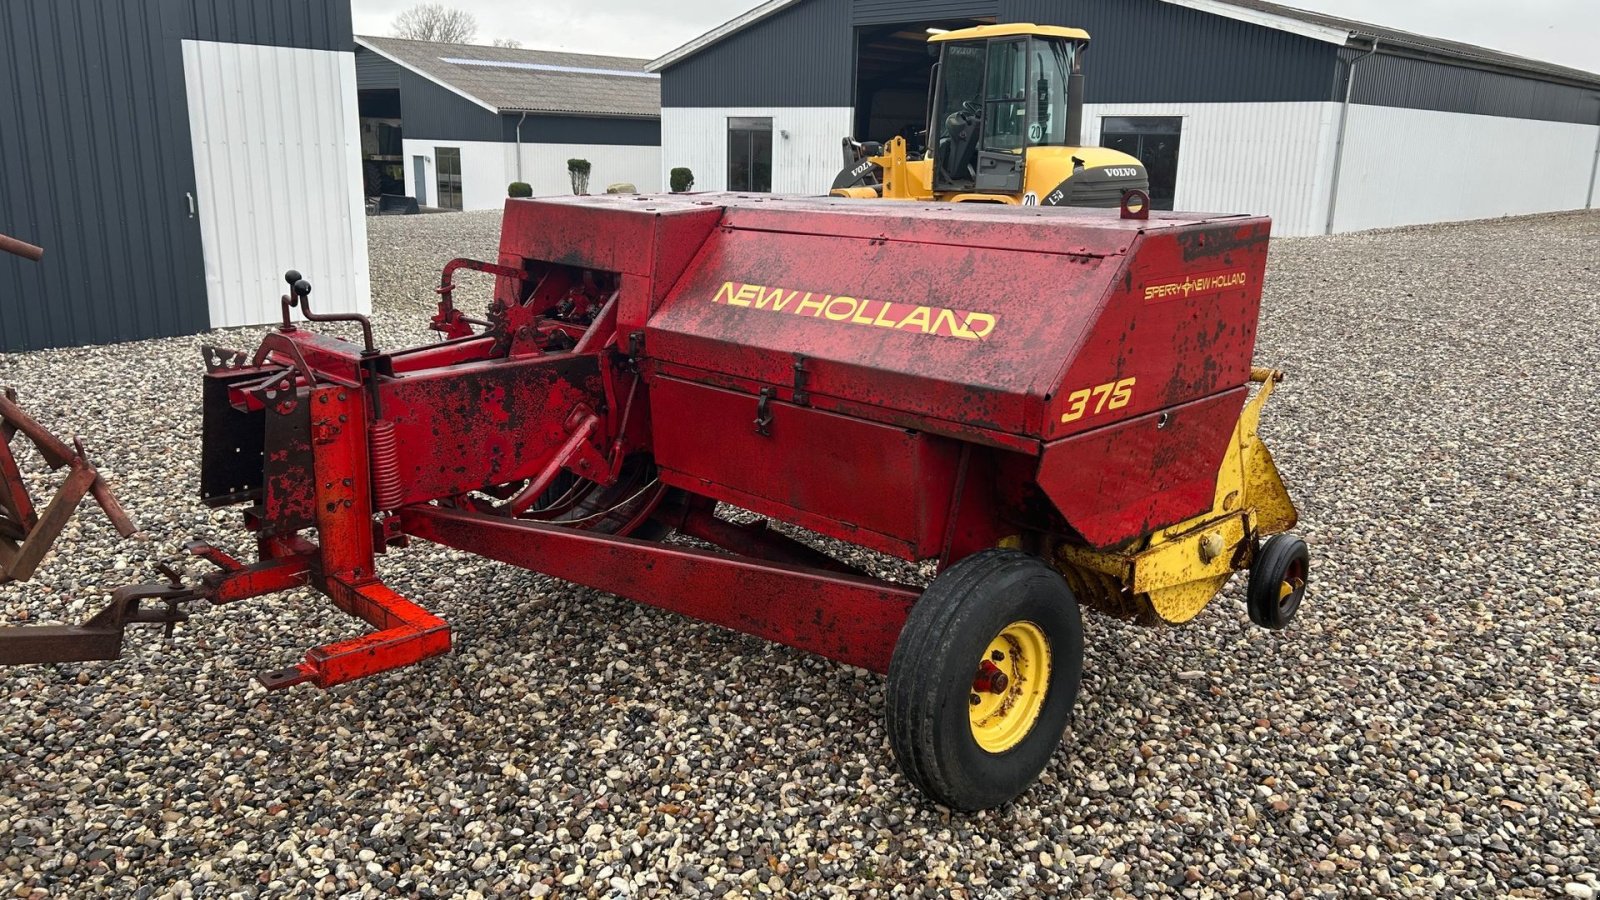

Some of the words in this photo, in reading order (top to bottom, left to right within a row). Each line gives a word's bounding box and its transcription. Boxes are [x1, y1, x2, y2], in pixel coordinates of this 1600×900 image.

[1031, 125, 1041, 139] 20
[851, 160, 873, 177] VOLV
[1103, 167, 1137, 177] VOLVO
[1025, 194, 1036, 206] 20
[1144, 283, 1182, 300] SPERRY
[1191, 277, 1211, 292] NEW
[1211, 272, 1246, 288] HOLLAND
[712, 281, 798, 311] NEW
[795, 292, 996, 340] HOLLAND
[1061, 376, 1136, 423] 375
